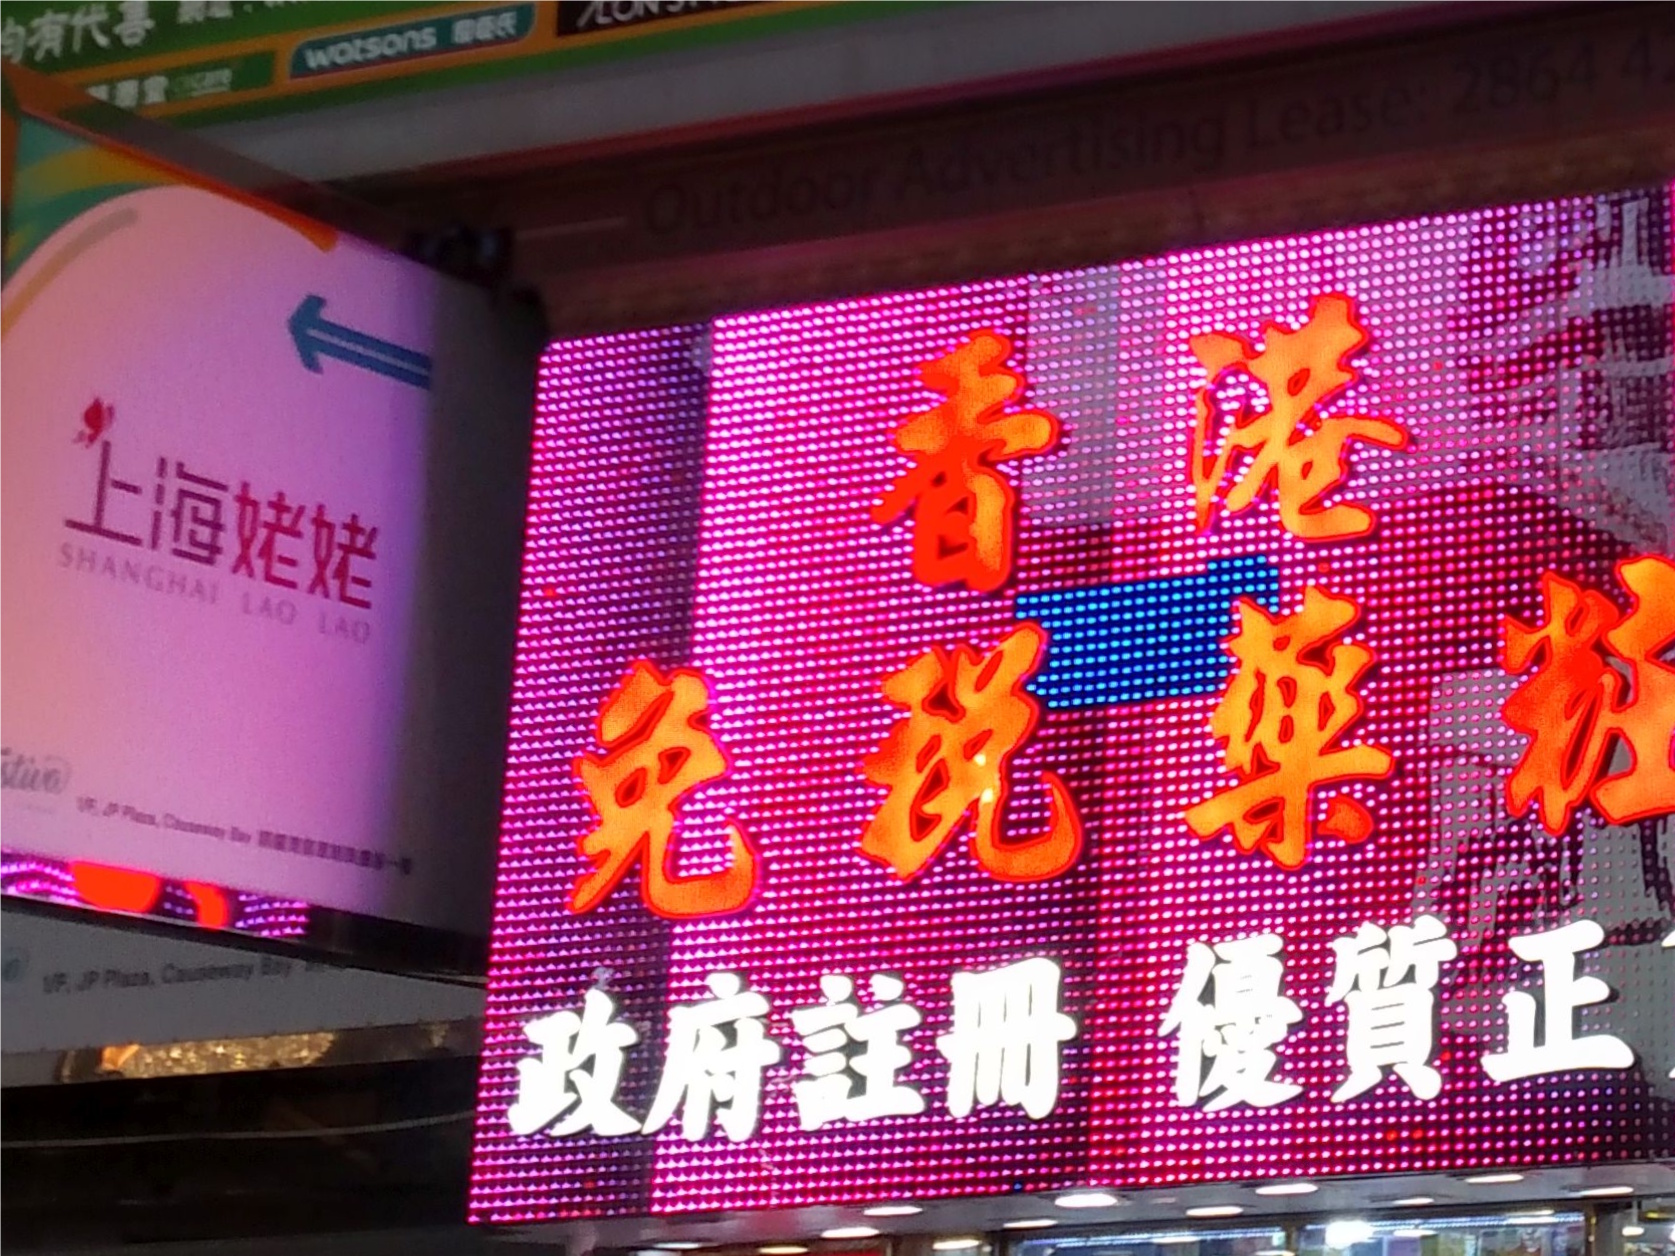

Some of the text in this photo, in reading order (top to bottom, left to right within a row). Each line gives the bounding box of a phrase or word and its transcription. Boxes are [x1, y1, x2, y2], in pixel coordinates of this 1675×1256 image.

[303, 26, 438, 70] watsons
[642, 159, 883, 241] Outdoor
[902, 85, 1230, 215] Advertising
[1246, 79, 1430, 153] Lease:
[1449, 44, 1603, 122] 2864
[64, 439, 379, 610] 上海姥姥
[869, 293, 1416, 594] 香港
[58, 541, 373, 646] SHANGHAI LAO LAO
[507, 955, 1077, 1142] 政府註冊
